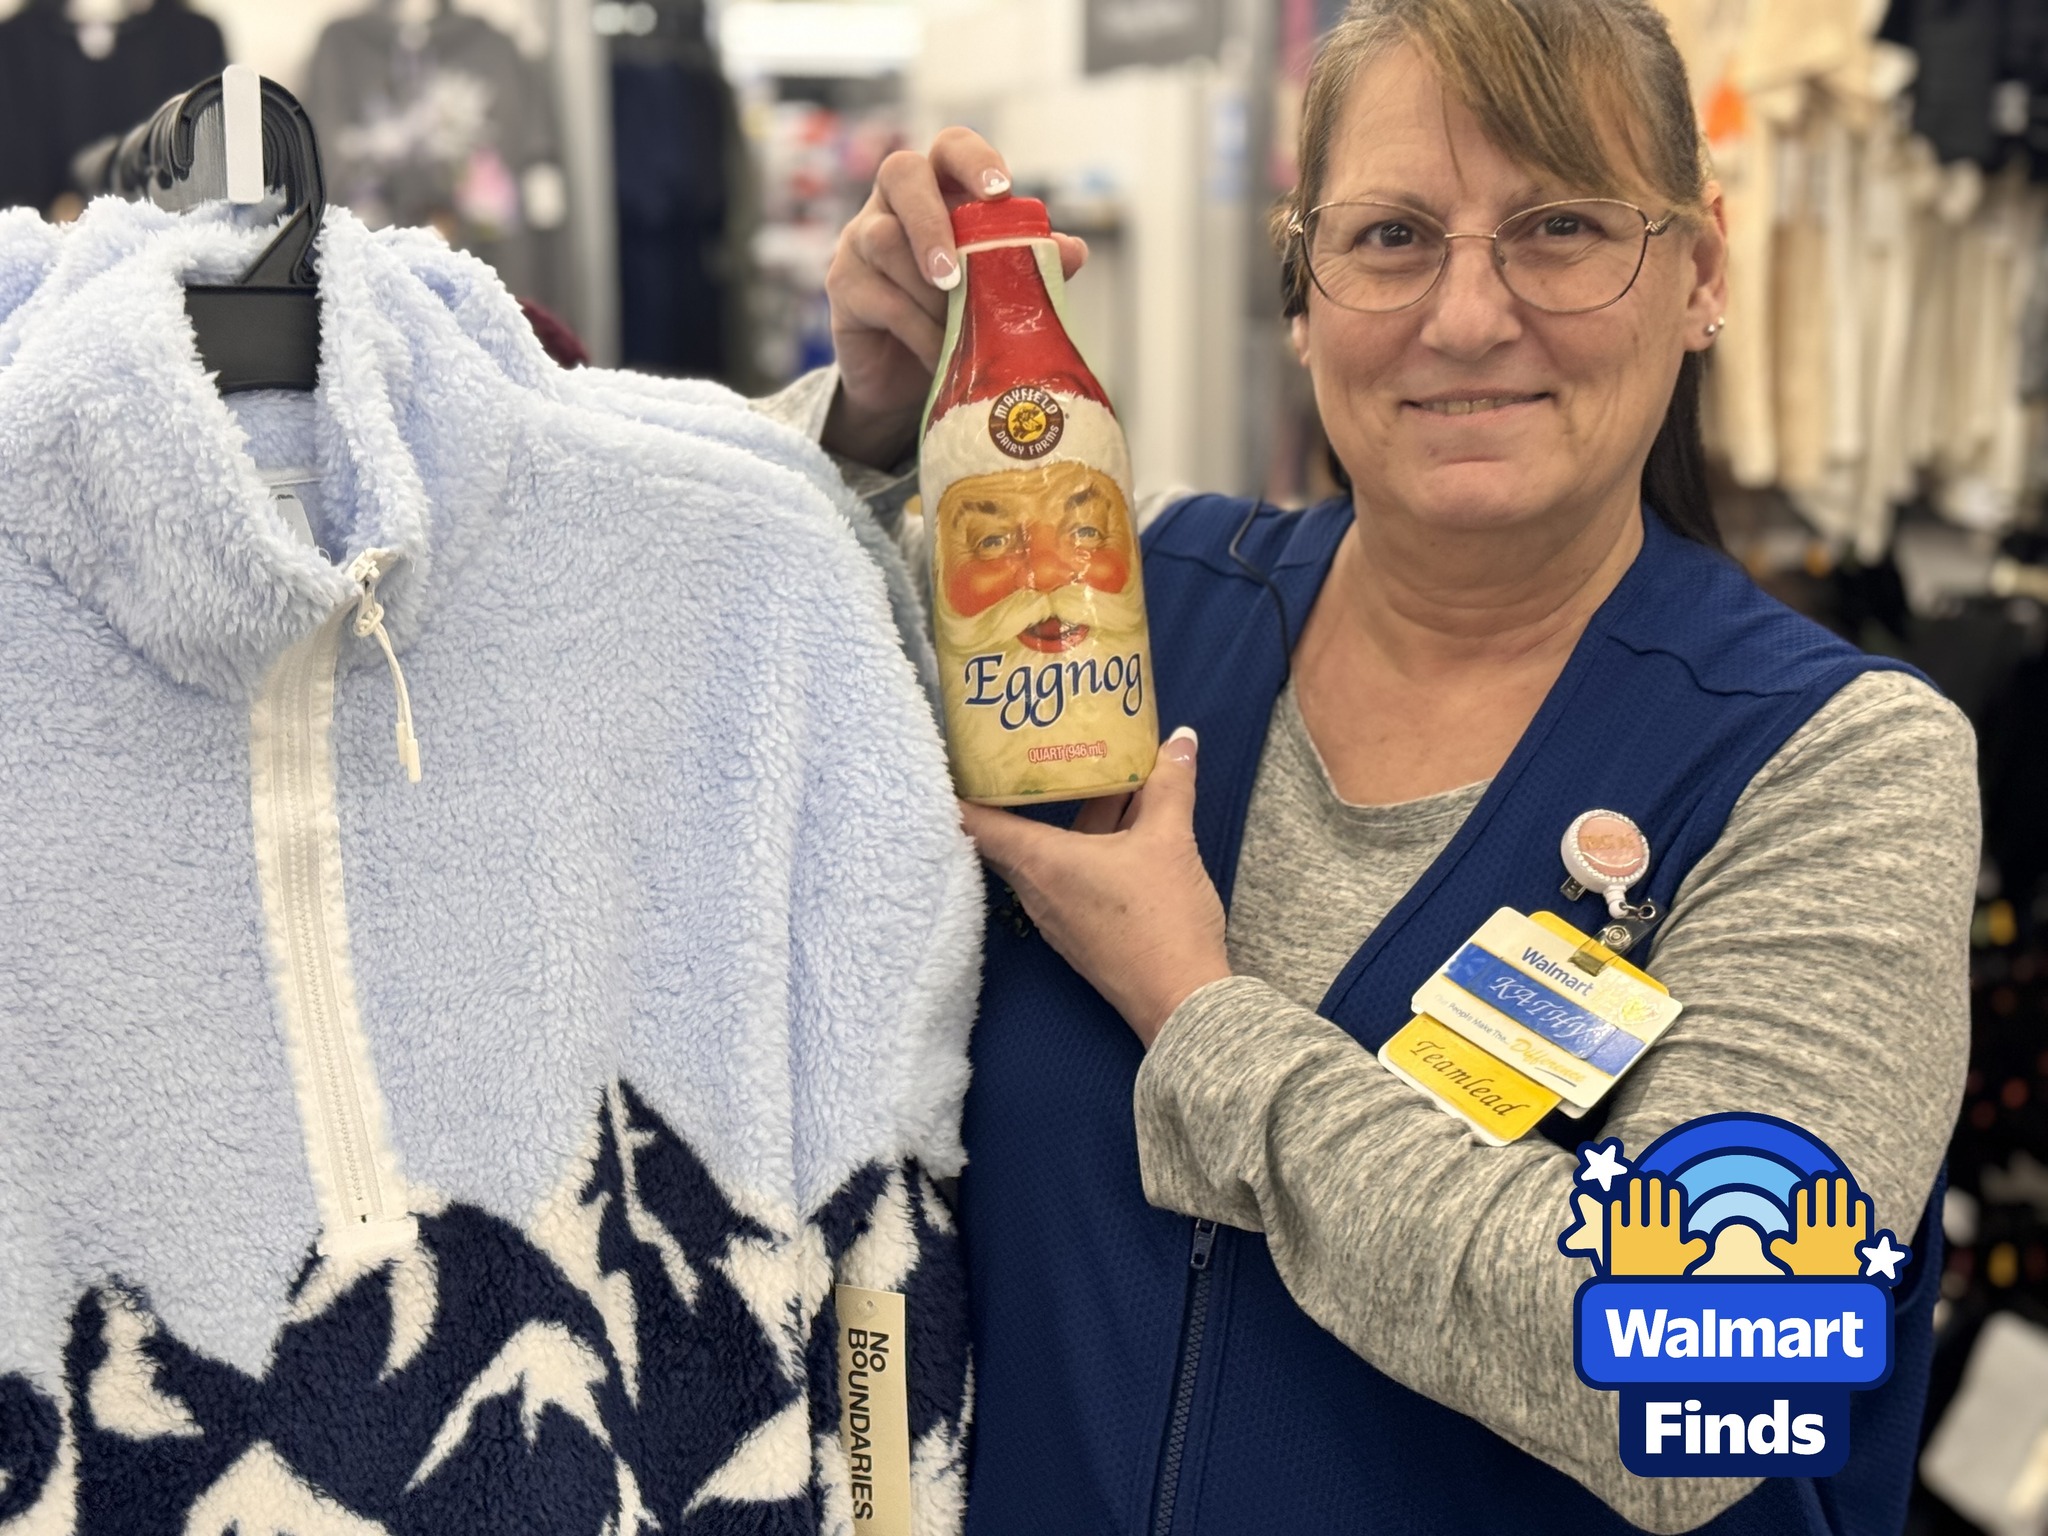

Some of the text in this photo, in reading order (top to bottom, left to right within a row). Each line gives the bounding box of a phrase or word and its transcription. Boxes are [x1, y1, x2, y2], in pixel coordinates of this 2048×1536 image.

[994, 388, 1059, 419] MAYFIELD
[995, 425, 1060, 456] DAIRY FARMS
[964, 653, 1143, 731] Eggnog
[1028, 747, 1063, 763] QUART
[1065, 744, 1087, 762] (946
[1521, 946, 1594, 996] Walmart
[1489, 976, 1587, 1038] KATHY
[1448, 1002, 1474, 1022] People
[1472, 1018, 1493, 1034] Make
[1509, 1037, 1587, 1083] Difference
[1410, 1040, 1530, 1117] Teamlead
[870, 1331, 889, 1373] NO
[848, 1328, 874, 1521] BOUNDARIES
